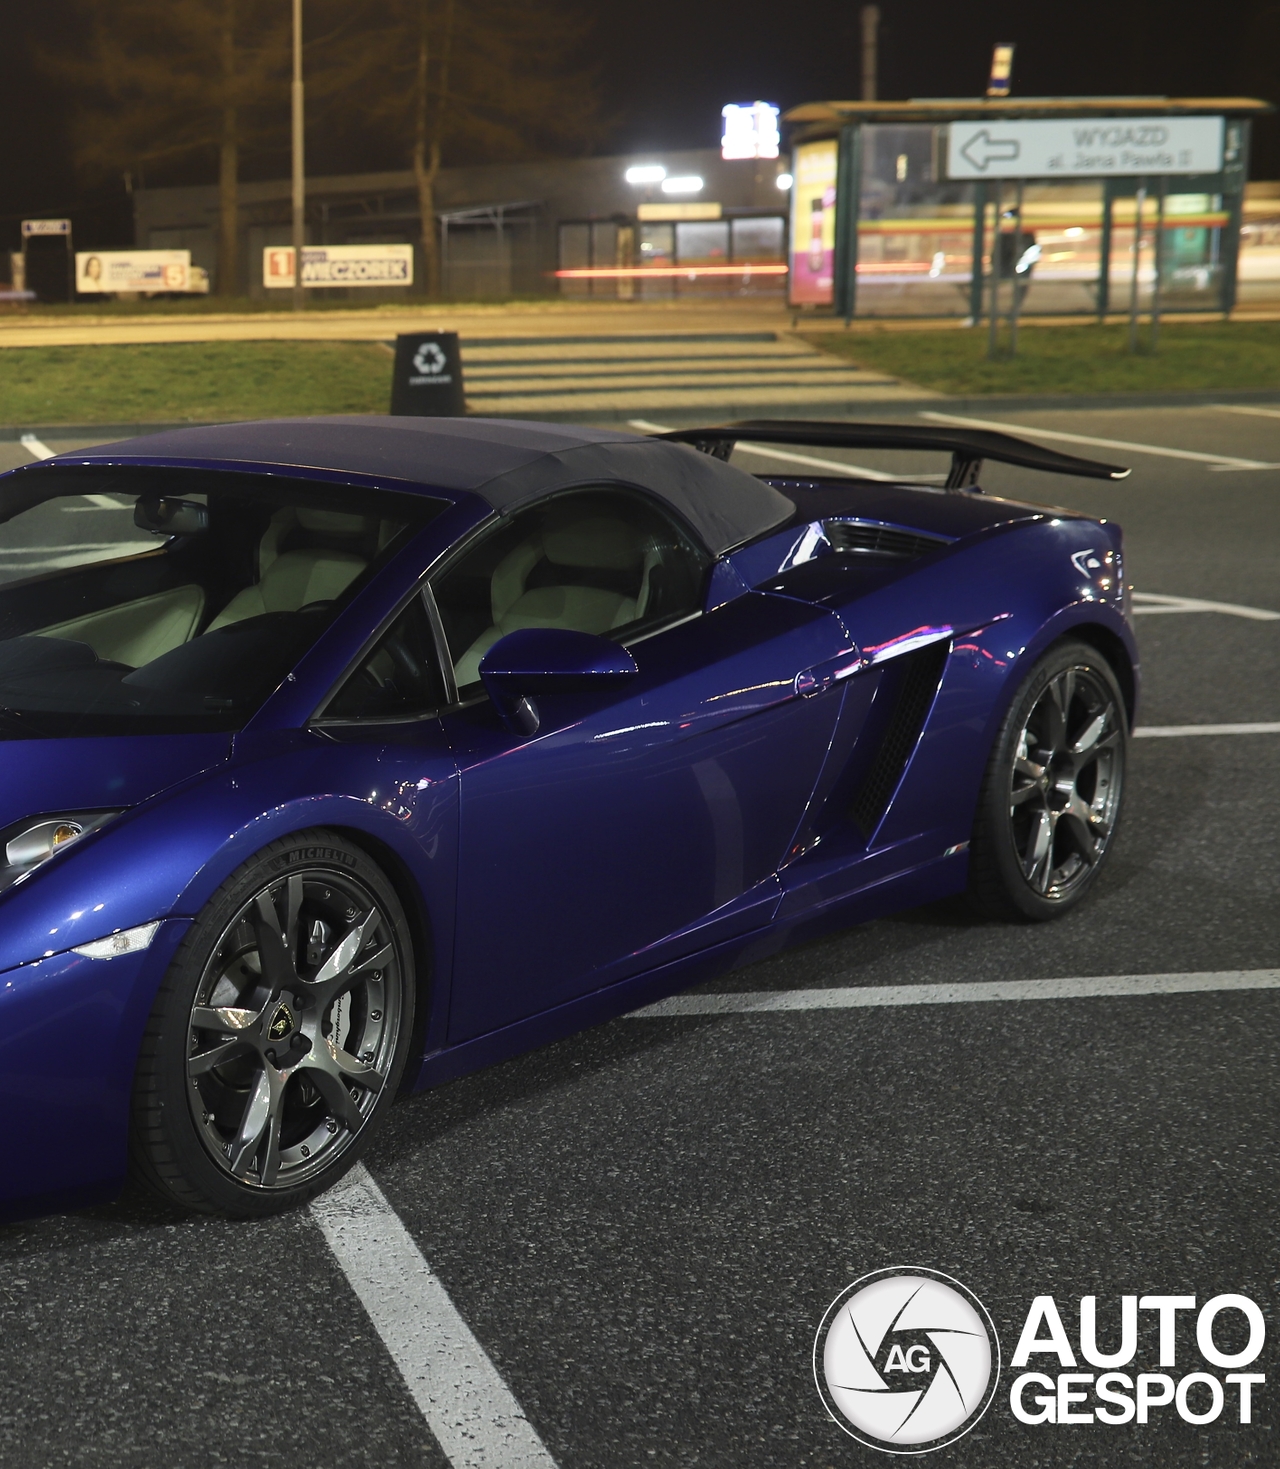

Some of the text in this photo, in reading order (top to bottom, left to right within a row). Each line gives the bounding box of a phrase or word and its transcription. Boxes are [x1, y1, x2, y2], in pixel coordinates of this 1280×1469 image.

[1072, 125, 1170, 147] WYJAZD
[1073, 152, 1114, 169] Jana
[1121, 150, 1173, 168] Pawła
[1178, 149, 1193, 167] II
[272, 252, 290, 276] 1
[289, 847, 354, 865] MICHELIN
